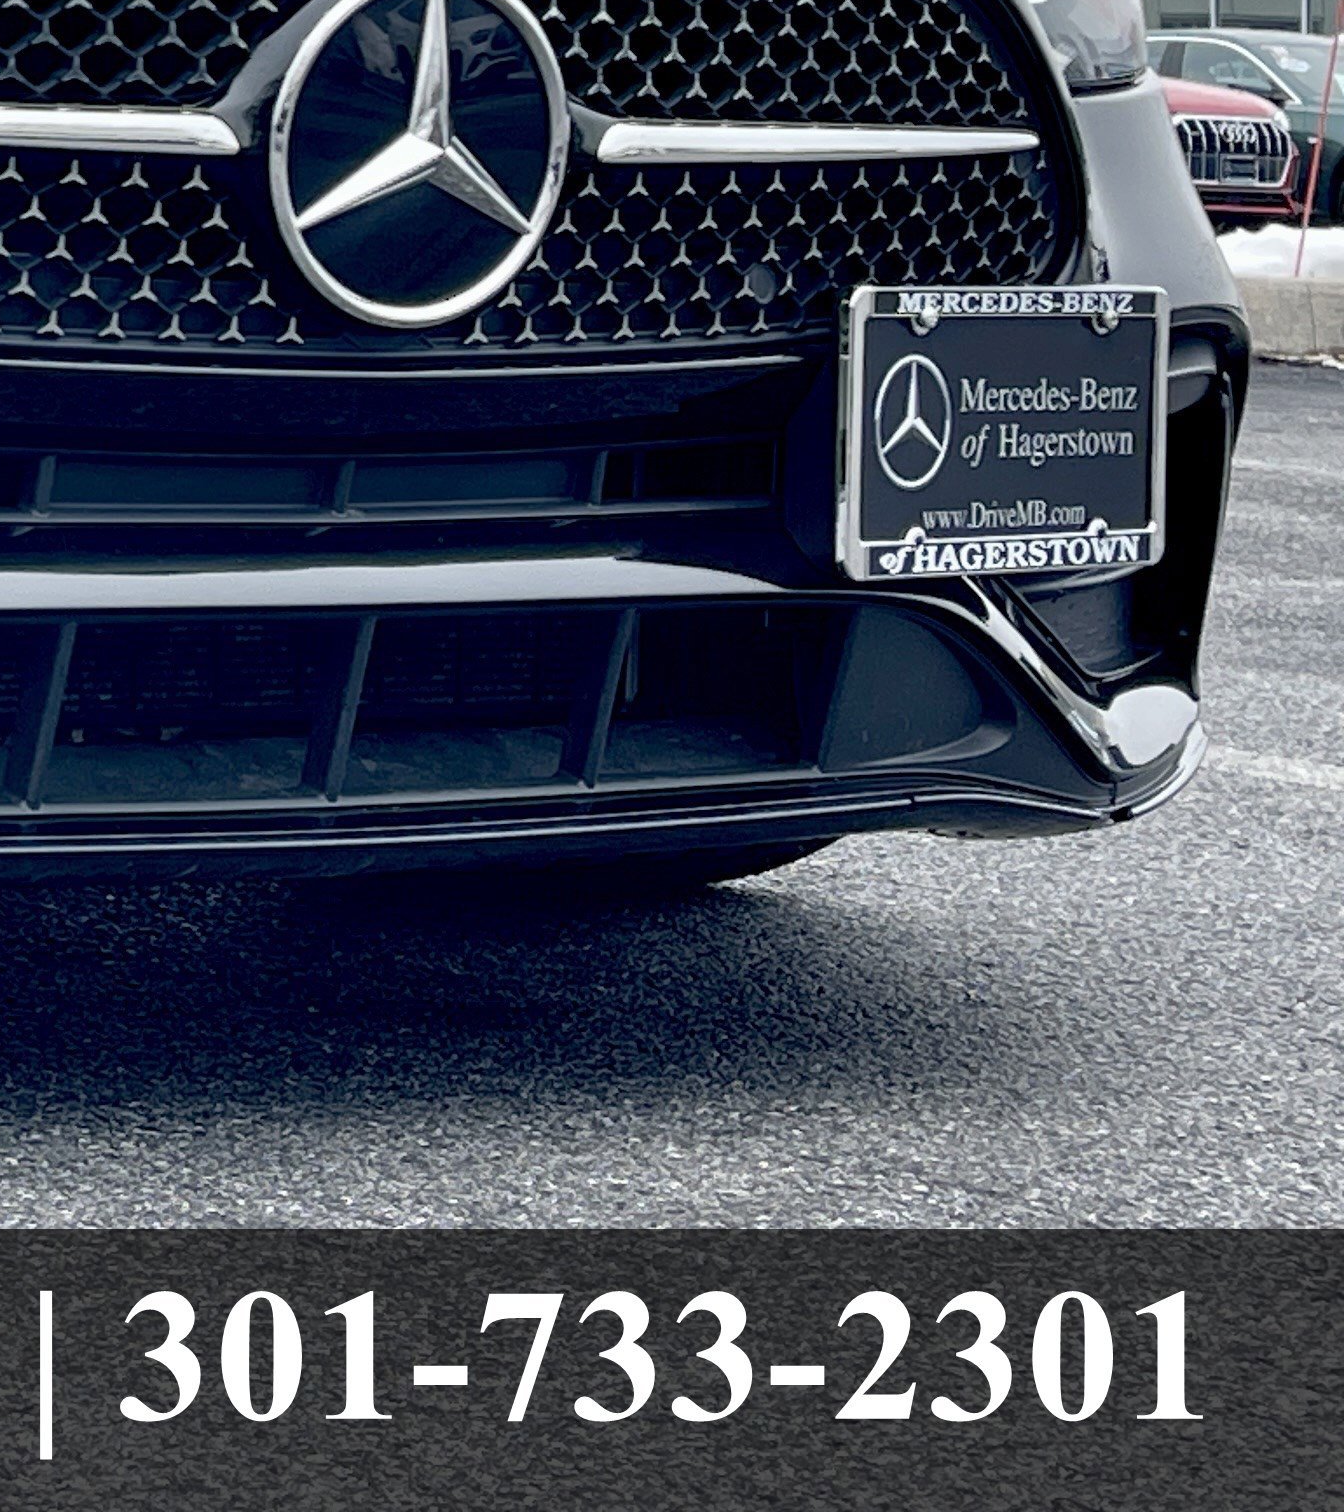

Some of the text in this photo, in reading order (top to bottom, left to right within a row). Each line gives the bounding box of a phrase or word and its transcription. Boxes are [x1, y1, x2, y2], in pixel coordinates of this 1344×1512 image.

[896, 291, 1134, 315] MERCEDES-BENZ
[959, 377, 1139, 414] Mercedes-Benz
[961, 424, 1134, 467] of Hagerstown
[922, 500, 1086, 530] www.DriveMB.com
[879, 535, 1141, 574] of HAGERSTOWN
